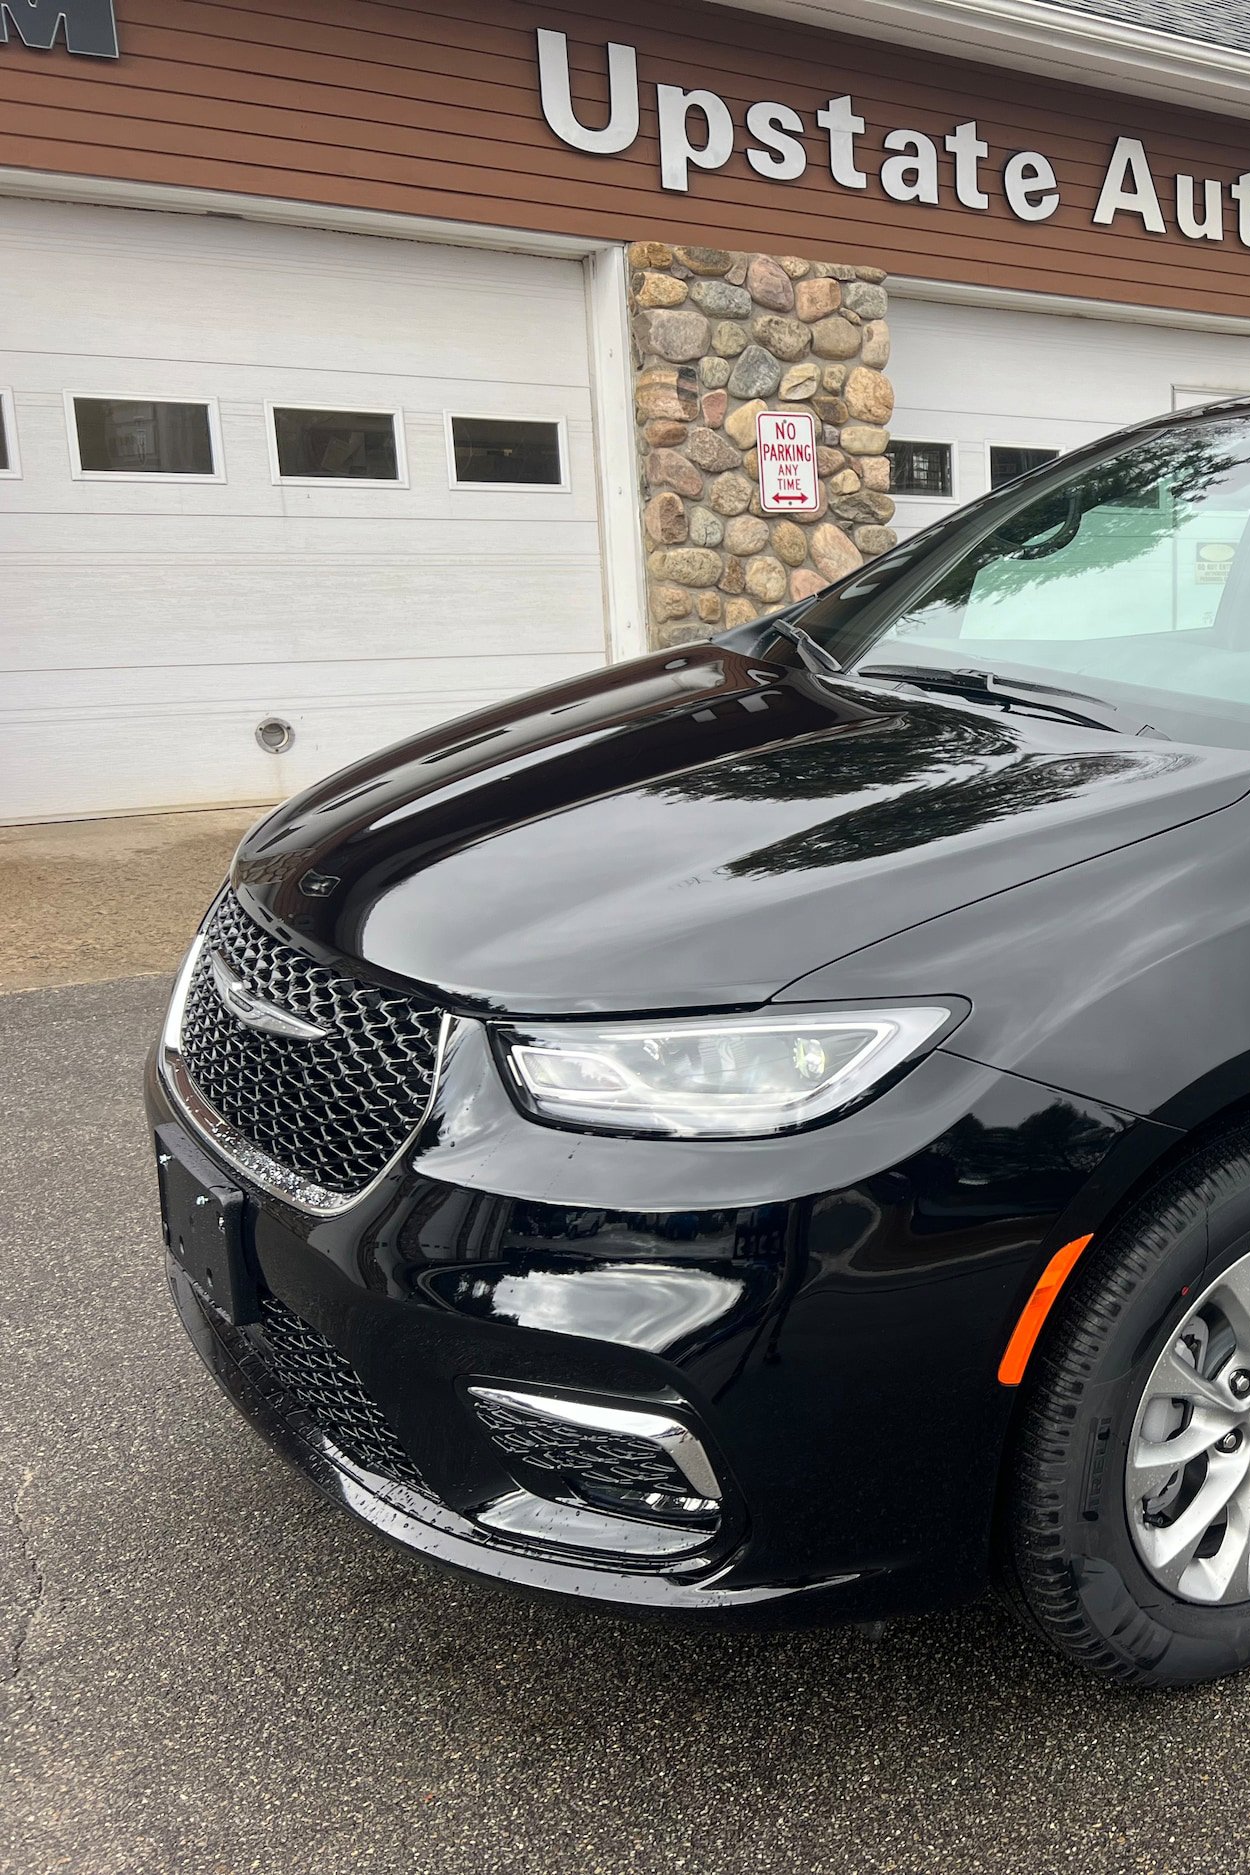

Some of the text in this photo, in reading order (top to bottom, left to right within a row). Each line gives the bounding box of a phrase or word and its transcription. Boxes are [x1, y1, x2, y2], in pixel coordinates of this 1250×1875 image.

[536, 28, 1061, 222] Upstate
[775, 422, 796, 440] NO
[763, 443, 812, 462] PARKING
[778, 464, 799, 477] ANY
[777, 478, 802, 491] TIME
